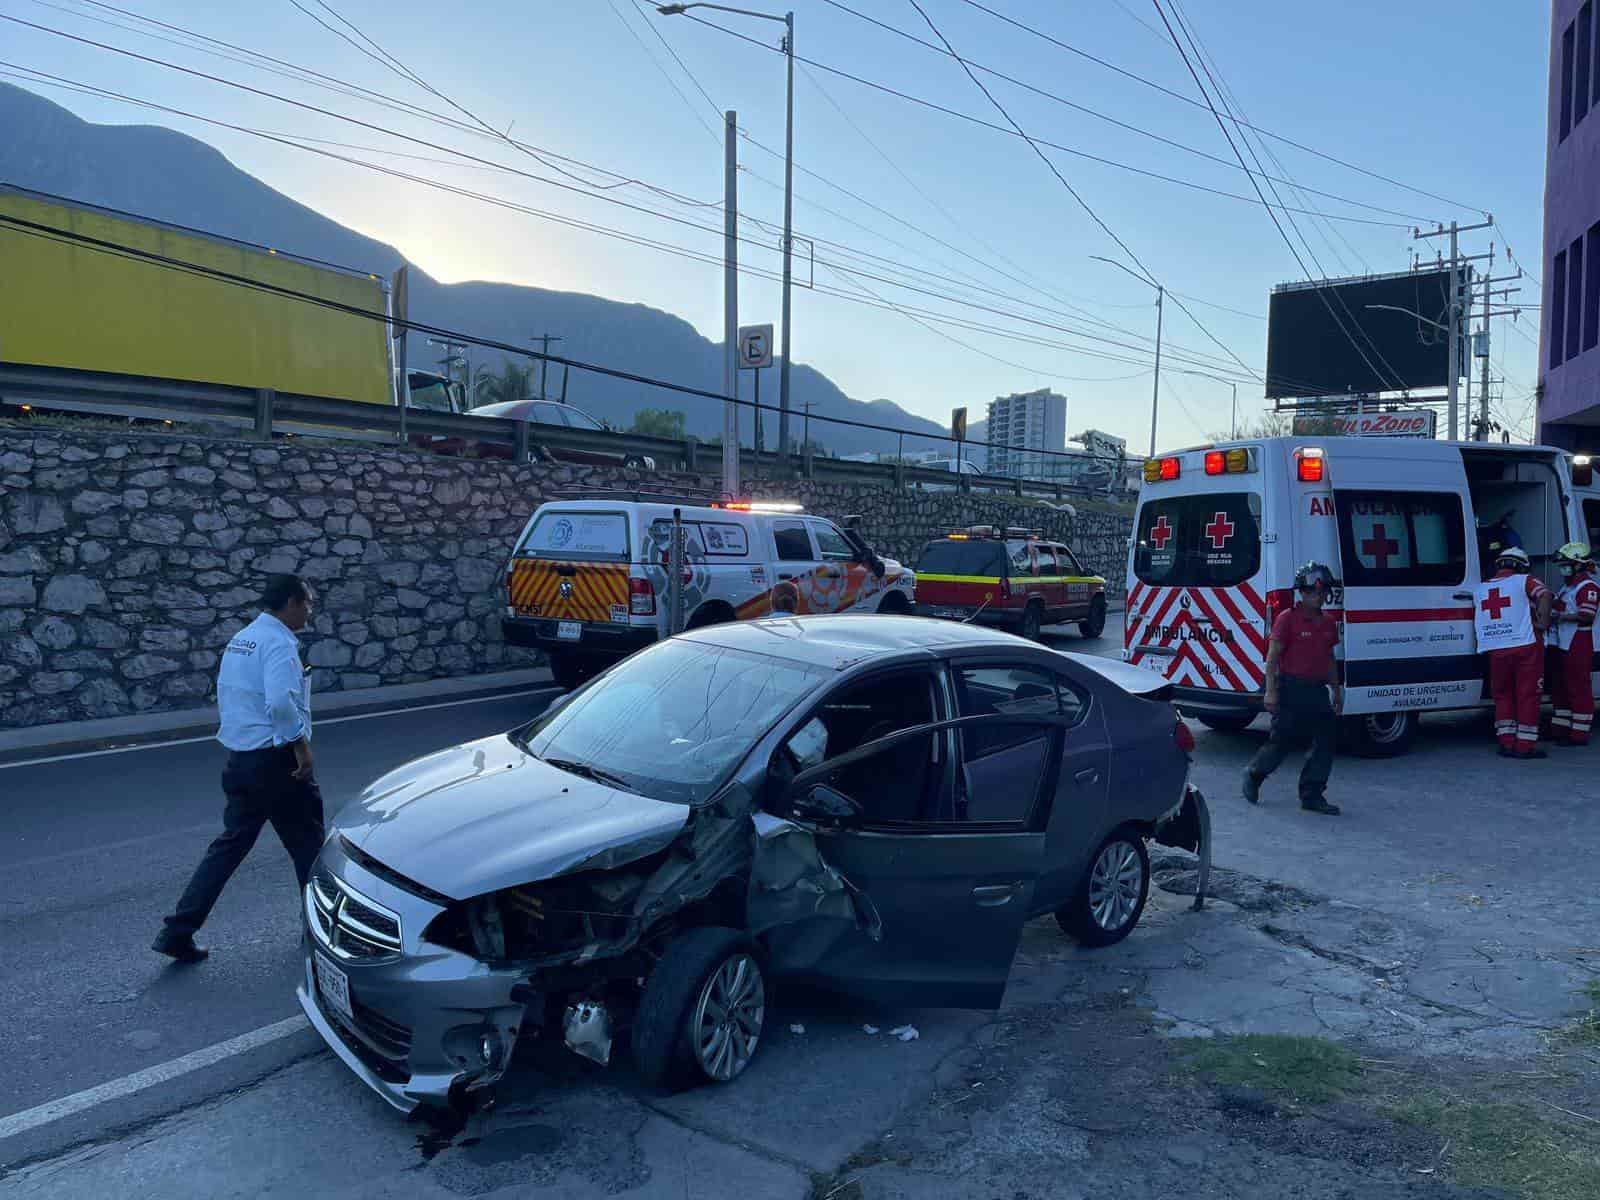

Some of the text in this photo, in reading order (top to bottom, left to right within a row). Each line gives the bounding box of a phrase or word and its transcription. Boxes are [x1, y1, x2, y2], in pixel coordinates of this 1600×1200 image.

[1367, 683, 1466, 698] UNIDAD DE URGENCIAS
